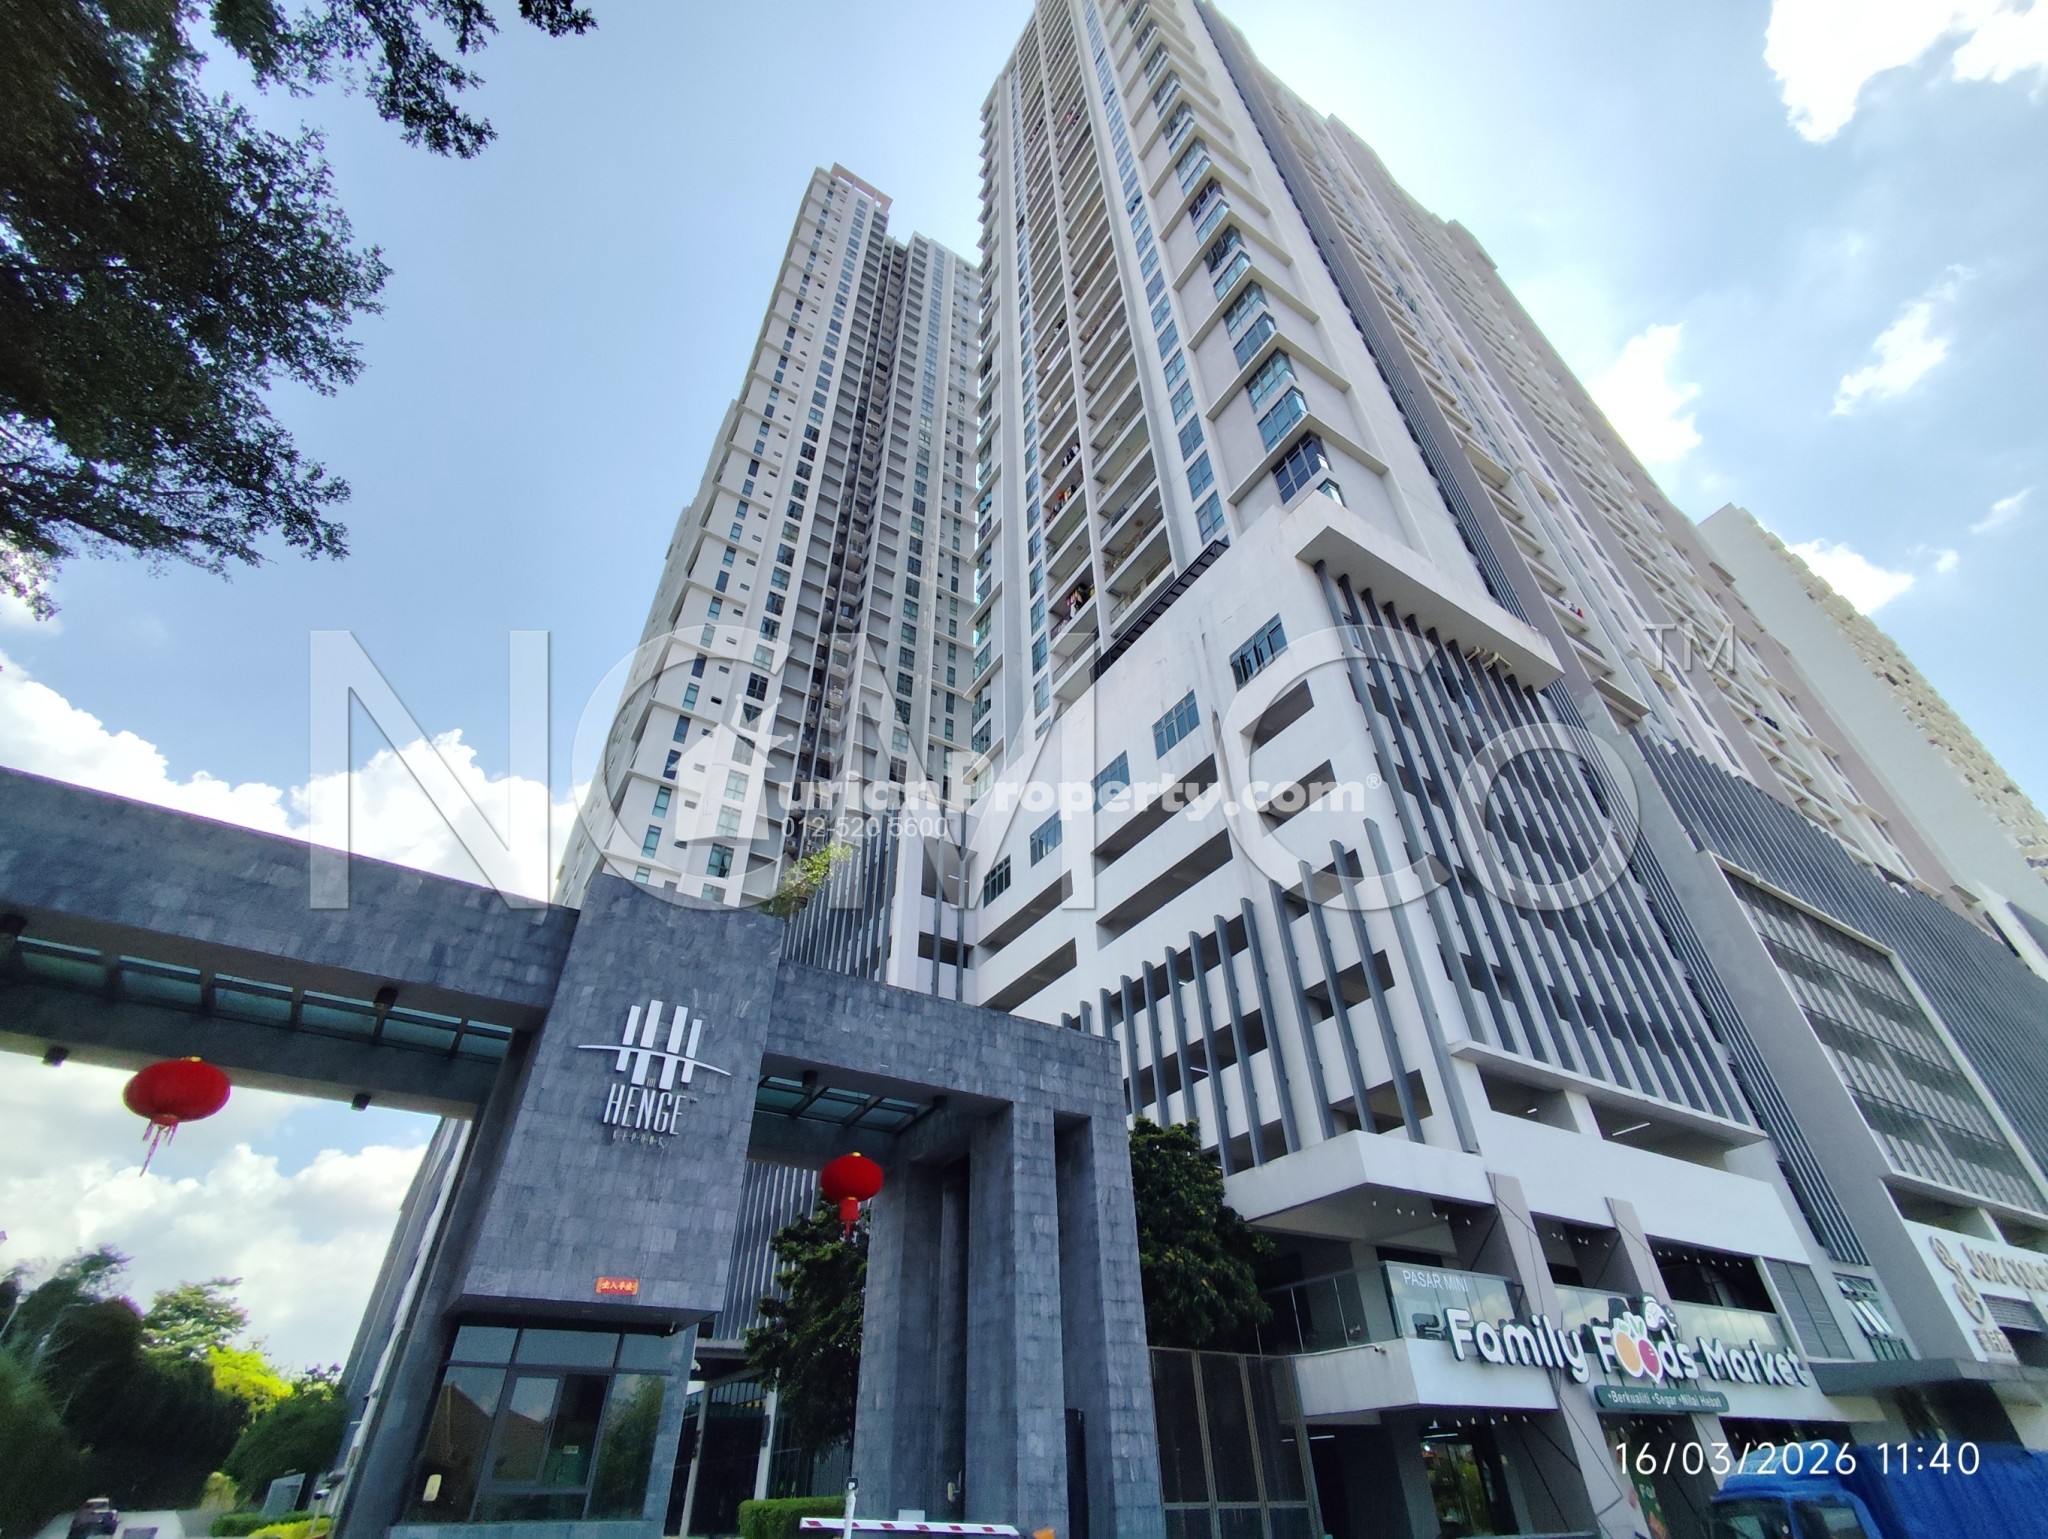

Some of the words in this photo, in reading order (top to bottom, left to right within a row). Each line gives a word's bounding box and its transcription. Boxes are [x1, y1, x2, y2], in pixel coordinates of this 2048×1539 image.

[602, 1082, 687, 1136] HENGE
[1402, 1269, 1443, 1290] PASAR
[1443, 1275, 1469, 1294] MINI
[1445, 1307, 1591, 1385] Family
[1697, 1335, 1810, 1388] Market
